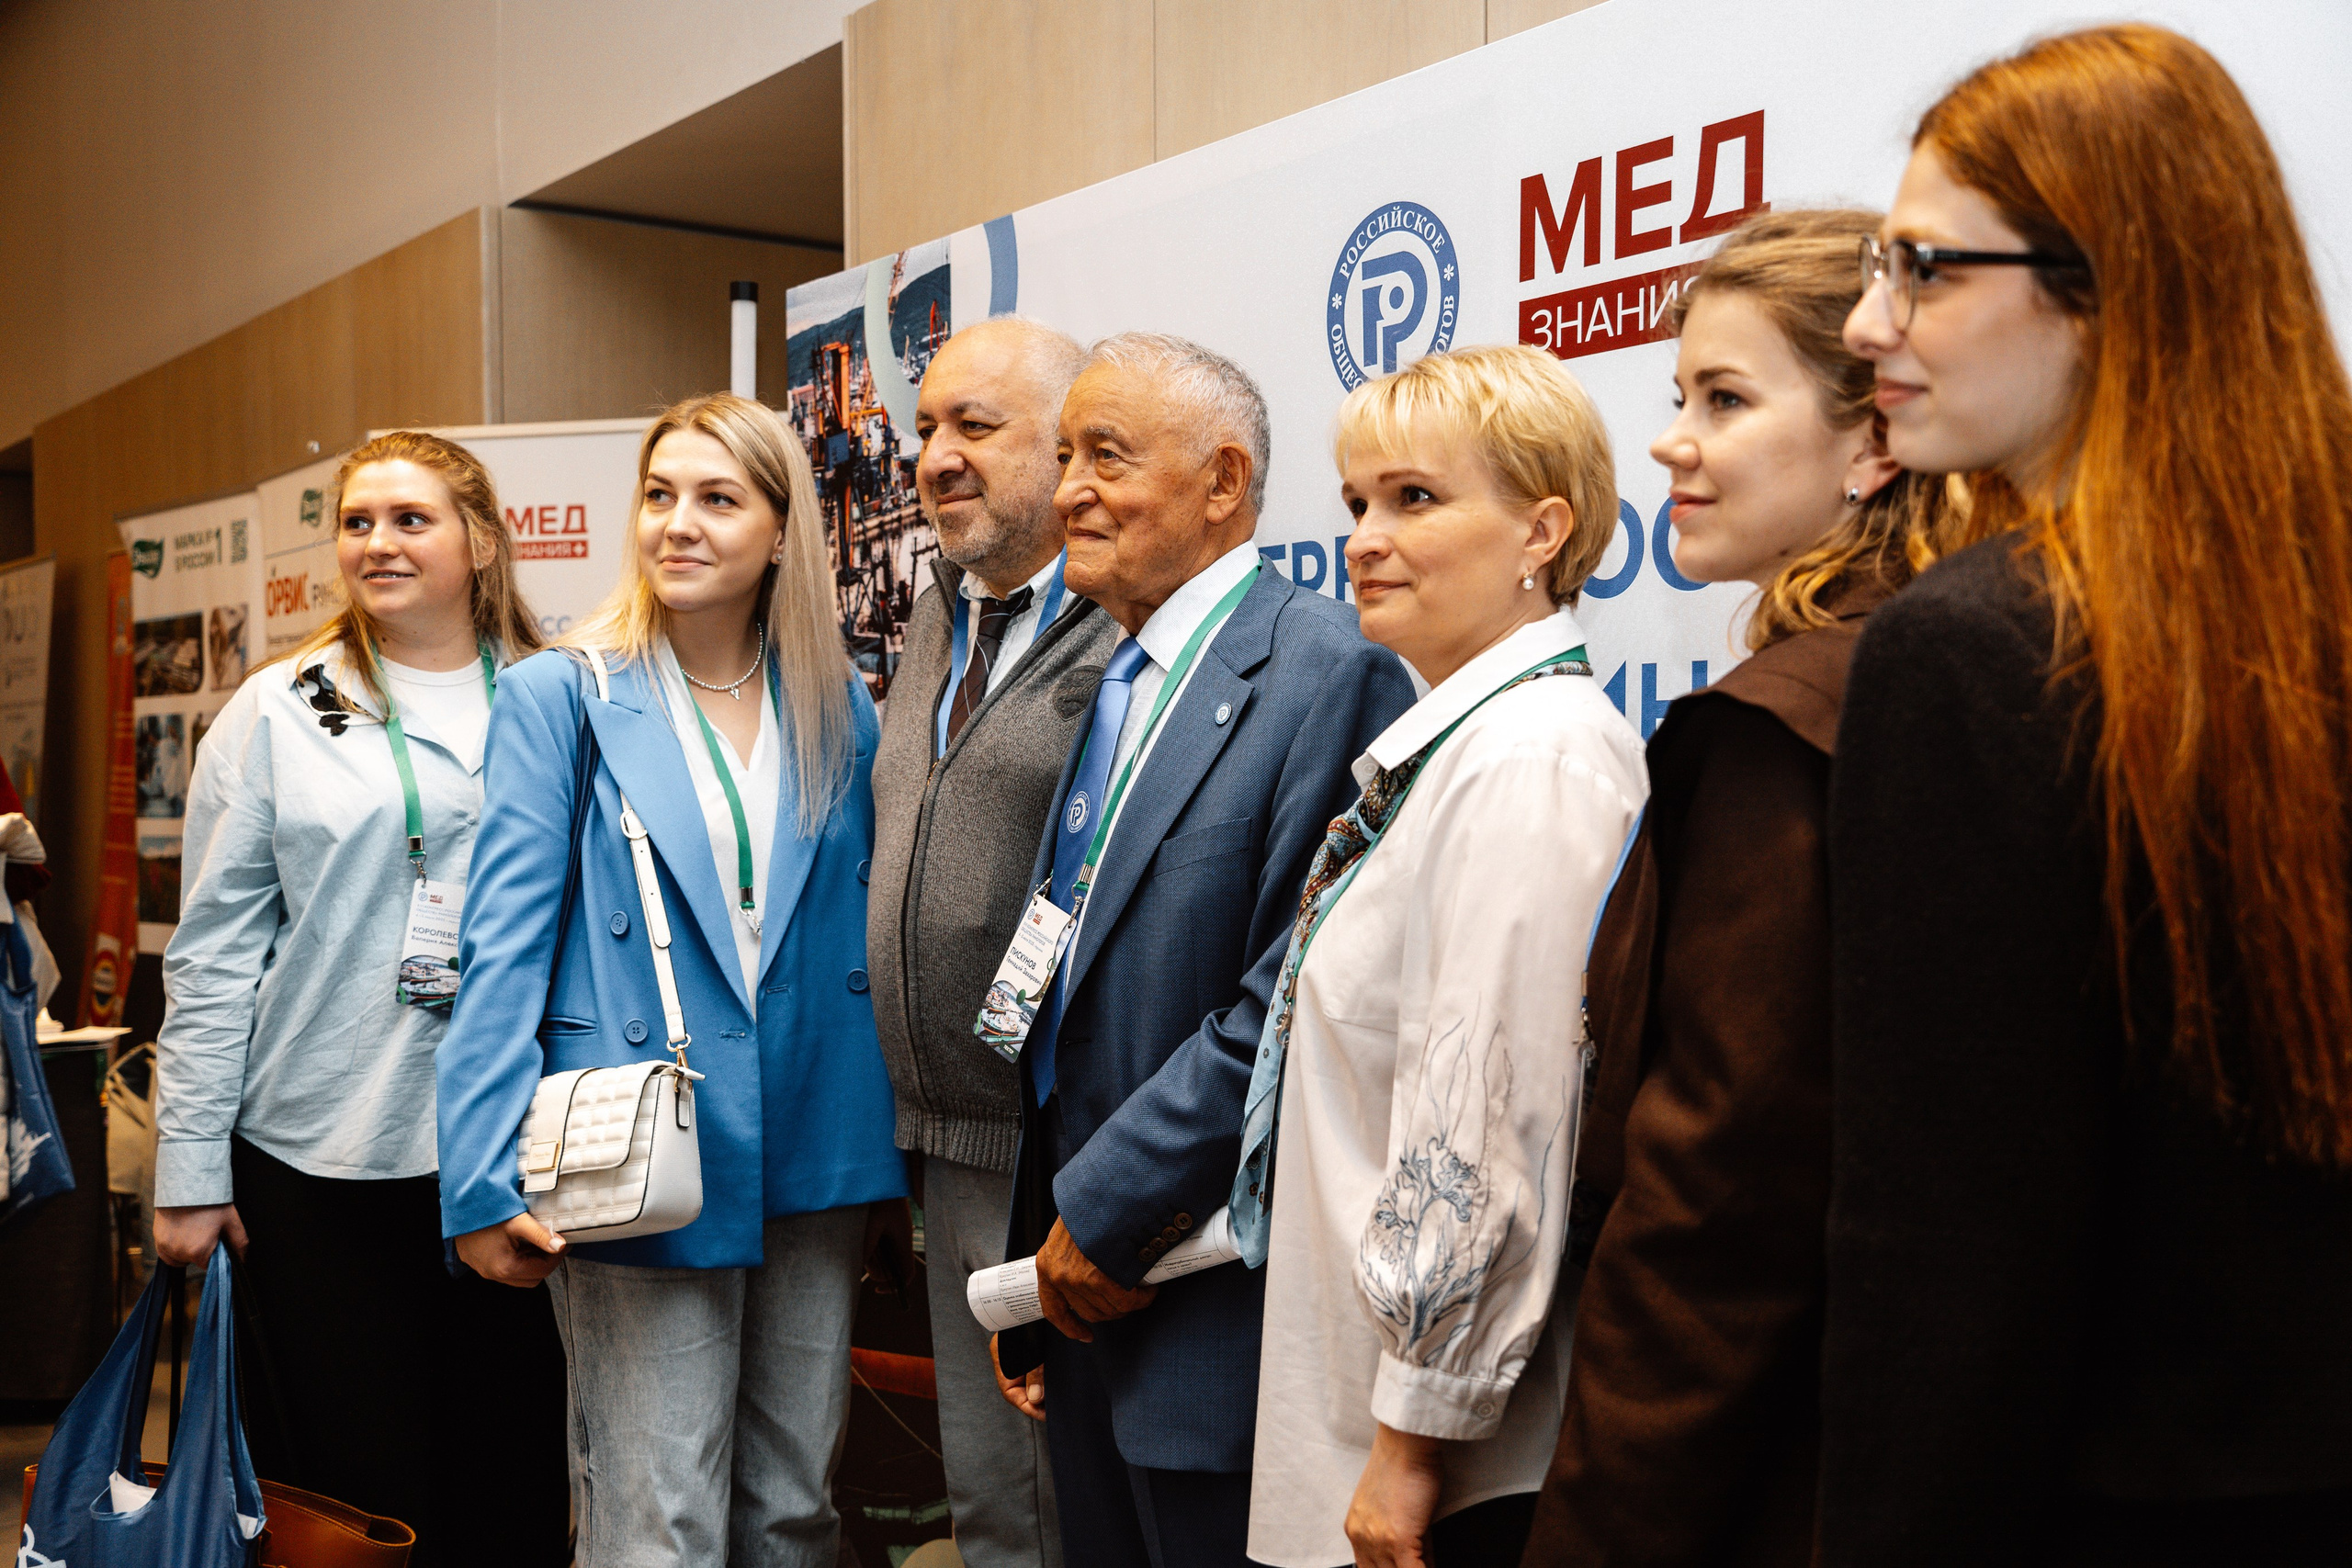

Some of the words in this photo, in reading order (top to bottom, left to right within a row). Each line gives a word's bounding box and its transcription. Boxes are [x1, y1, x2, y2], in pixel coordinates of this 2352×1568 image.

[1519, 108, 1771, 283] МЕД
[1340, 205, 1445, 279] РОССИЙСКОЕ
[1530, 276, 1701, 352] ЗНАНИ
[505, 504, 588, 536] МЕД
[514, 543, 571, 557] НАНИЯ
[1010, 946, 1037, 970] ПИСКУНОВ
